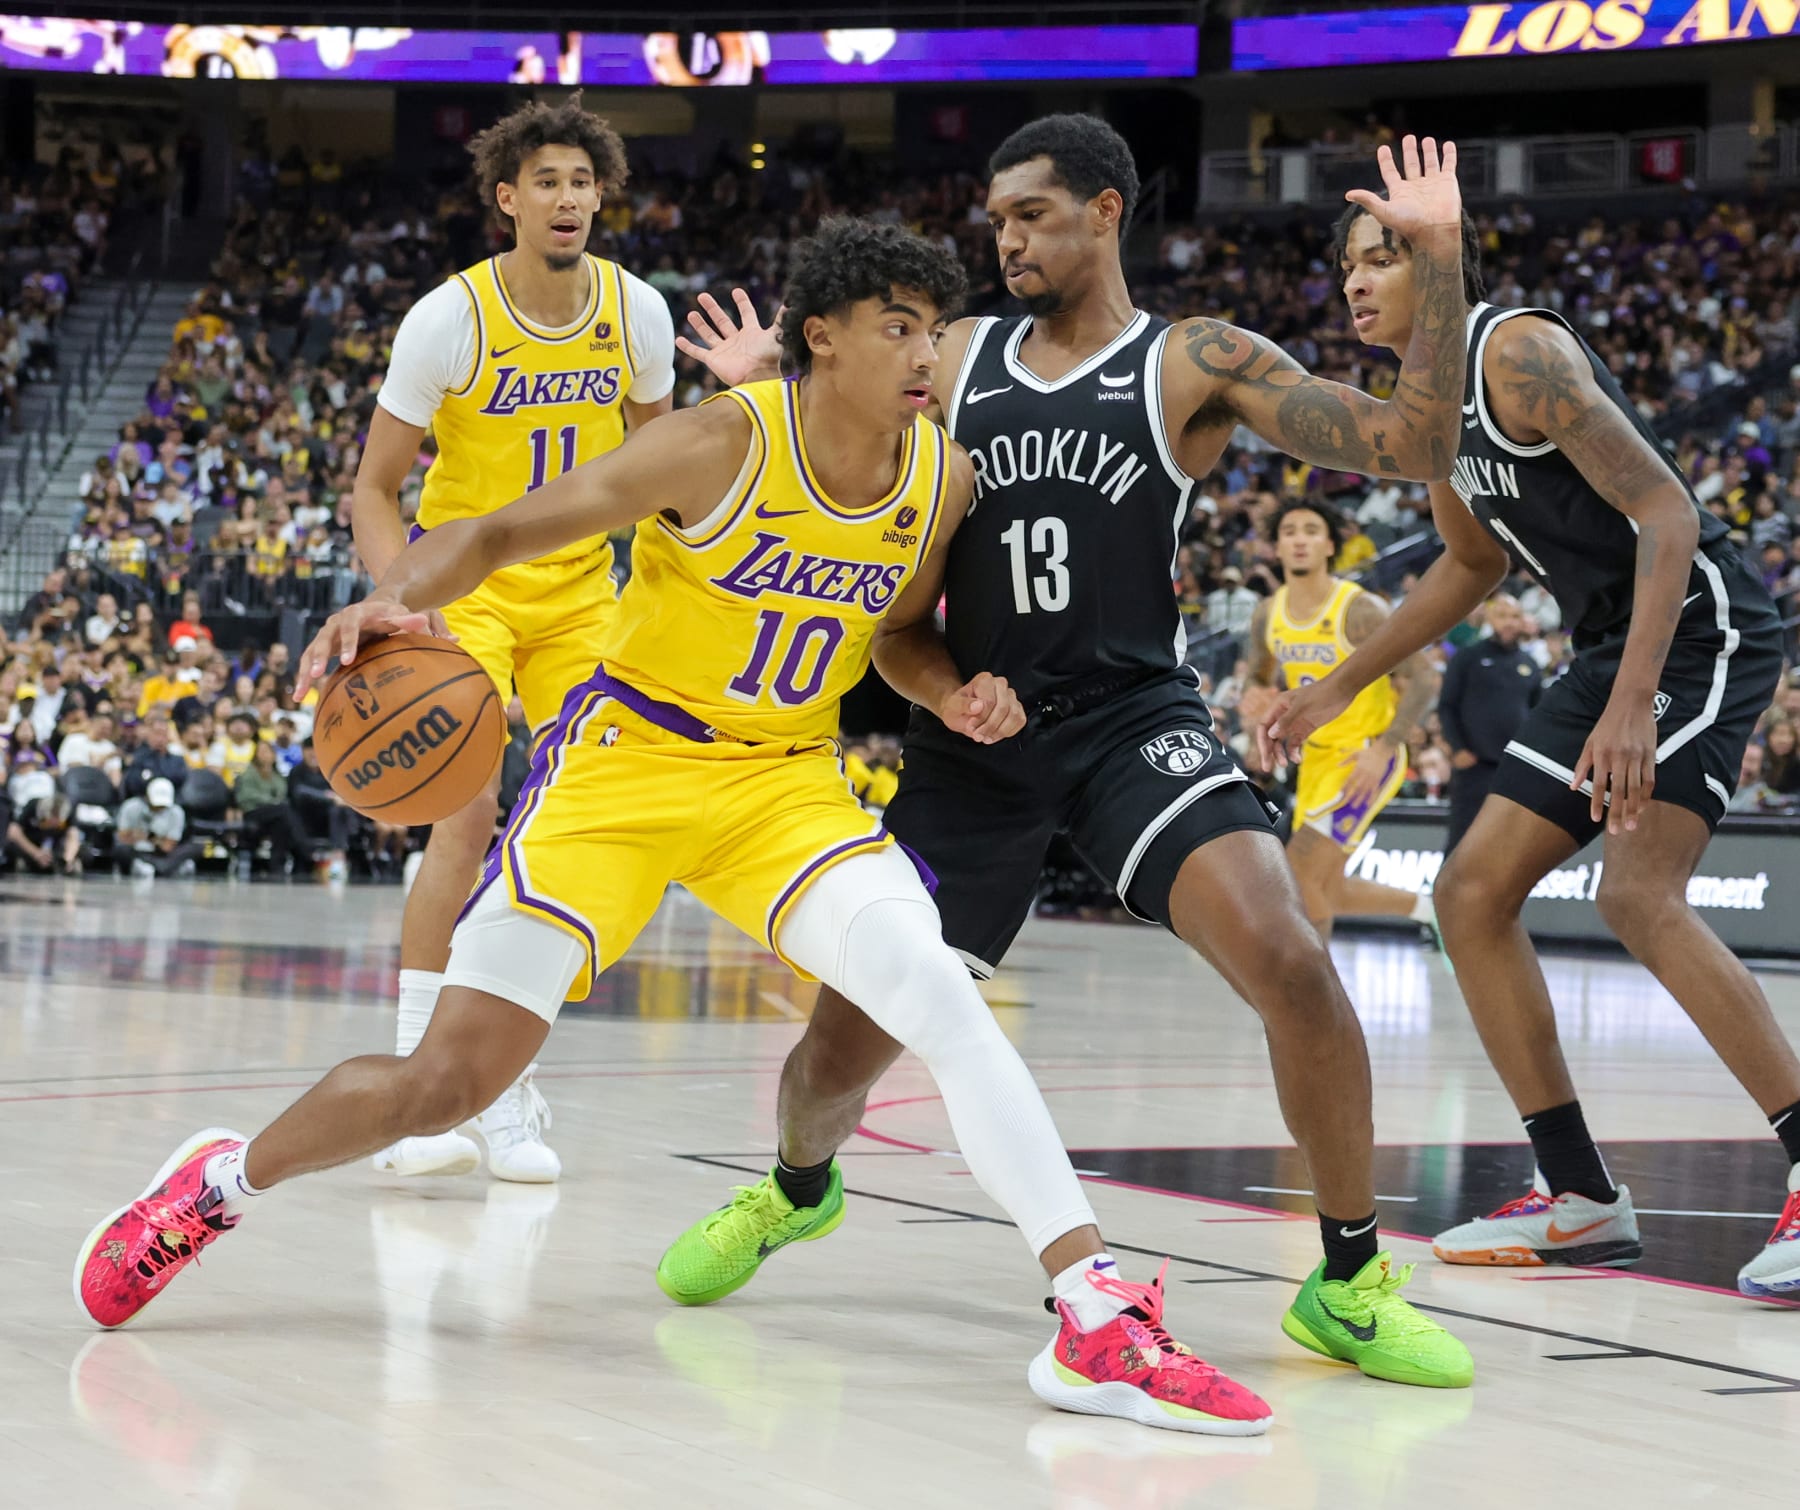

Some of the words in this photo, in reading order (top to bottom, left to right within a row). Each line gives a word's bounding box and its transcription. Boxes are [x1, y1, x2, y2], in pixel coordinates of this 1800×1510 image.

[1449, 0, 1650, 57] LOS
[590, 341, 620, 352] bibigo
[479, 365, 621, 415] LAKERS
[525, 425, 578, 494] 11
[967, 427, 1148, 518] ROOKLYN
[882, 530, 917, 548] bibigo
[1000, 516, 1071, 614] 13
[709, 531, 907, 614] LAKERS
[725, 608, 844, 707] 10
[344, 704, 463, 790] Wilson
[1145, 732, 1209, 763] NETS
[1177, 751, 1194, 768] B
